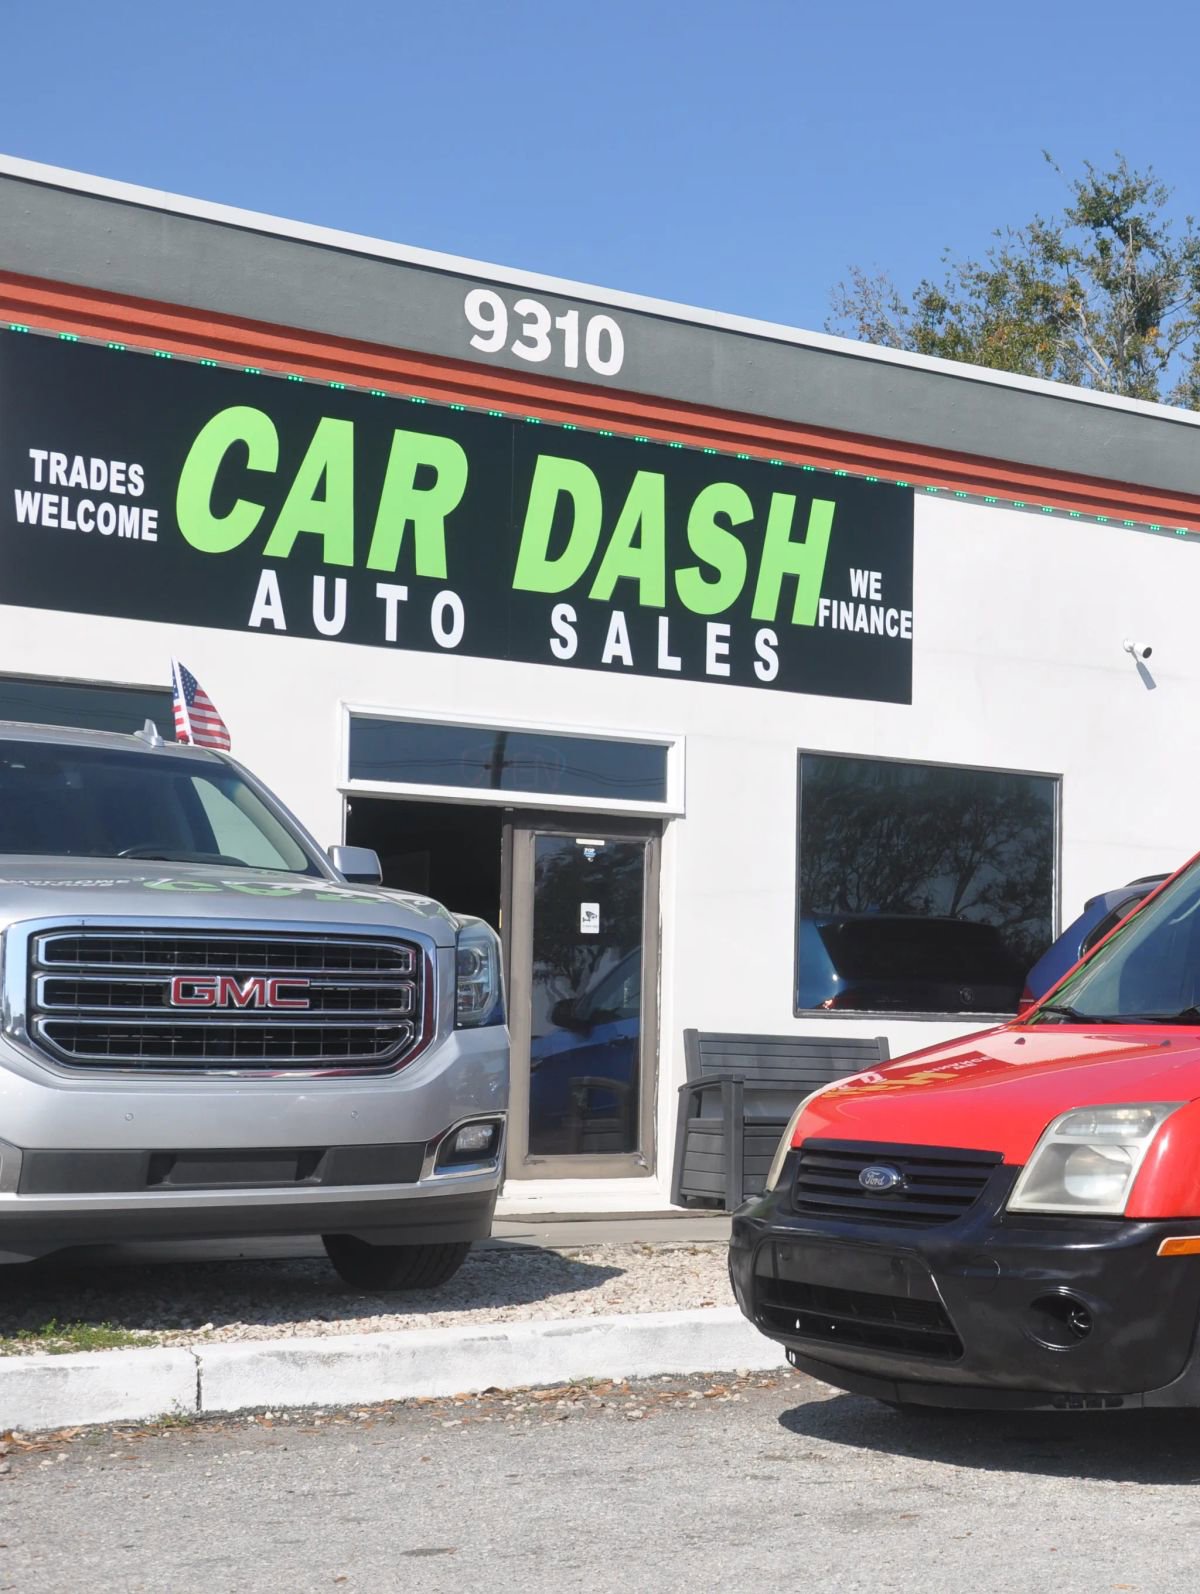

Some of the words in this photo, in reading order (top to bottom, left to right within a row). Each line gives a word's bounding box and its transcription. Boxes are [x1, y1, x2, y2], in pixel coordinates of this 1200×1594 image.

[463, 288, 625, 377] 9310
[29, 448, 145, 497] TRADES
[14, 488, 159, 542] WELCOME
[175, 405, 469, 579] CAR
[512, 454, 836, 626] DASH
[849, 567, 882, 601] WE
[247, 568, 465, 649] AUTO
[549, 603, 780, 682] SALES
[818, 597, 912, 640] FINANCE
[171, 975, 310, 1008] GMC
[864, 1171, 885, 1186] Ford
